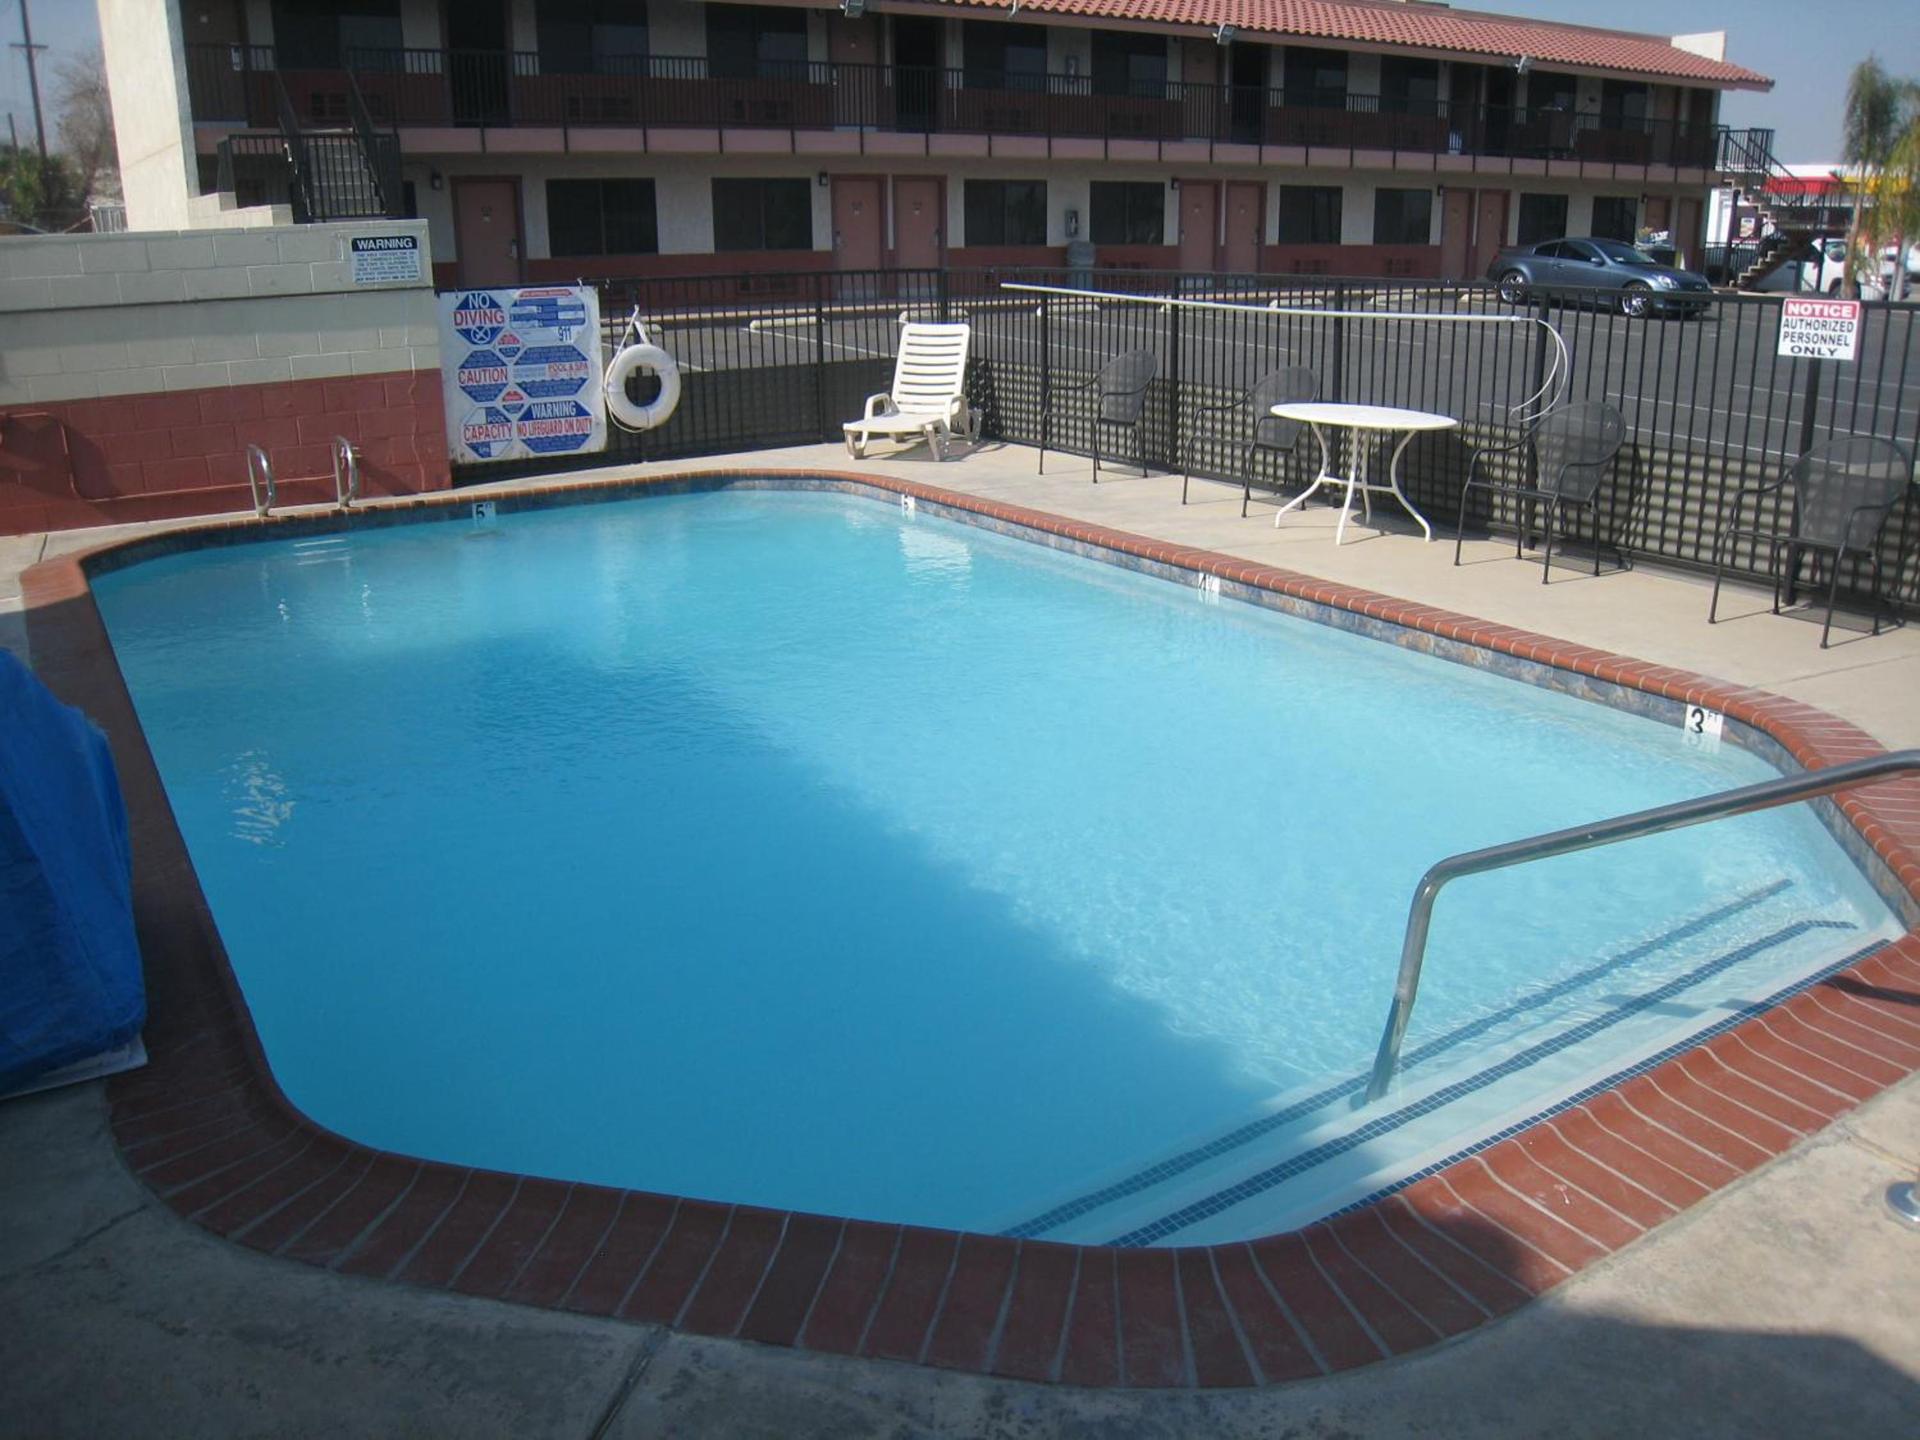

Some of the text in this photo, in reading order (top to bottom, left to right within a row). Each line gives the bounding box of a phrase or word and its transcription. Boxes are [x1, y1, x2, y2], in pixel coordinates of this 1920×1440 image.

[356, 238, 413, 250] WARNING
[468, 293, 490, 309] NO
[453, 310, 505, 326] DIVING
[1787, 303, 1853, 317] NOTICE
[557, 326, 572, 341] 911
[1783, 318, 1855, 333] AUTHORIZED
[1783, 331, 1850, 346] PERSONNEL
[1790, 345, 1838, 356] ONLY
[458, 367, 508, 385] CAUTION
[531, 401, 577, 419] WARNING
[464, 423, 512, 442] CAPACITY
[517, 417, 592, 437] NO LIFEGUARD ON DUTY
[1689, 708, 1705, 734] 3
